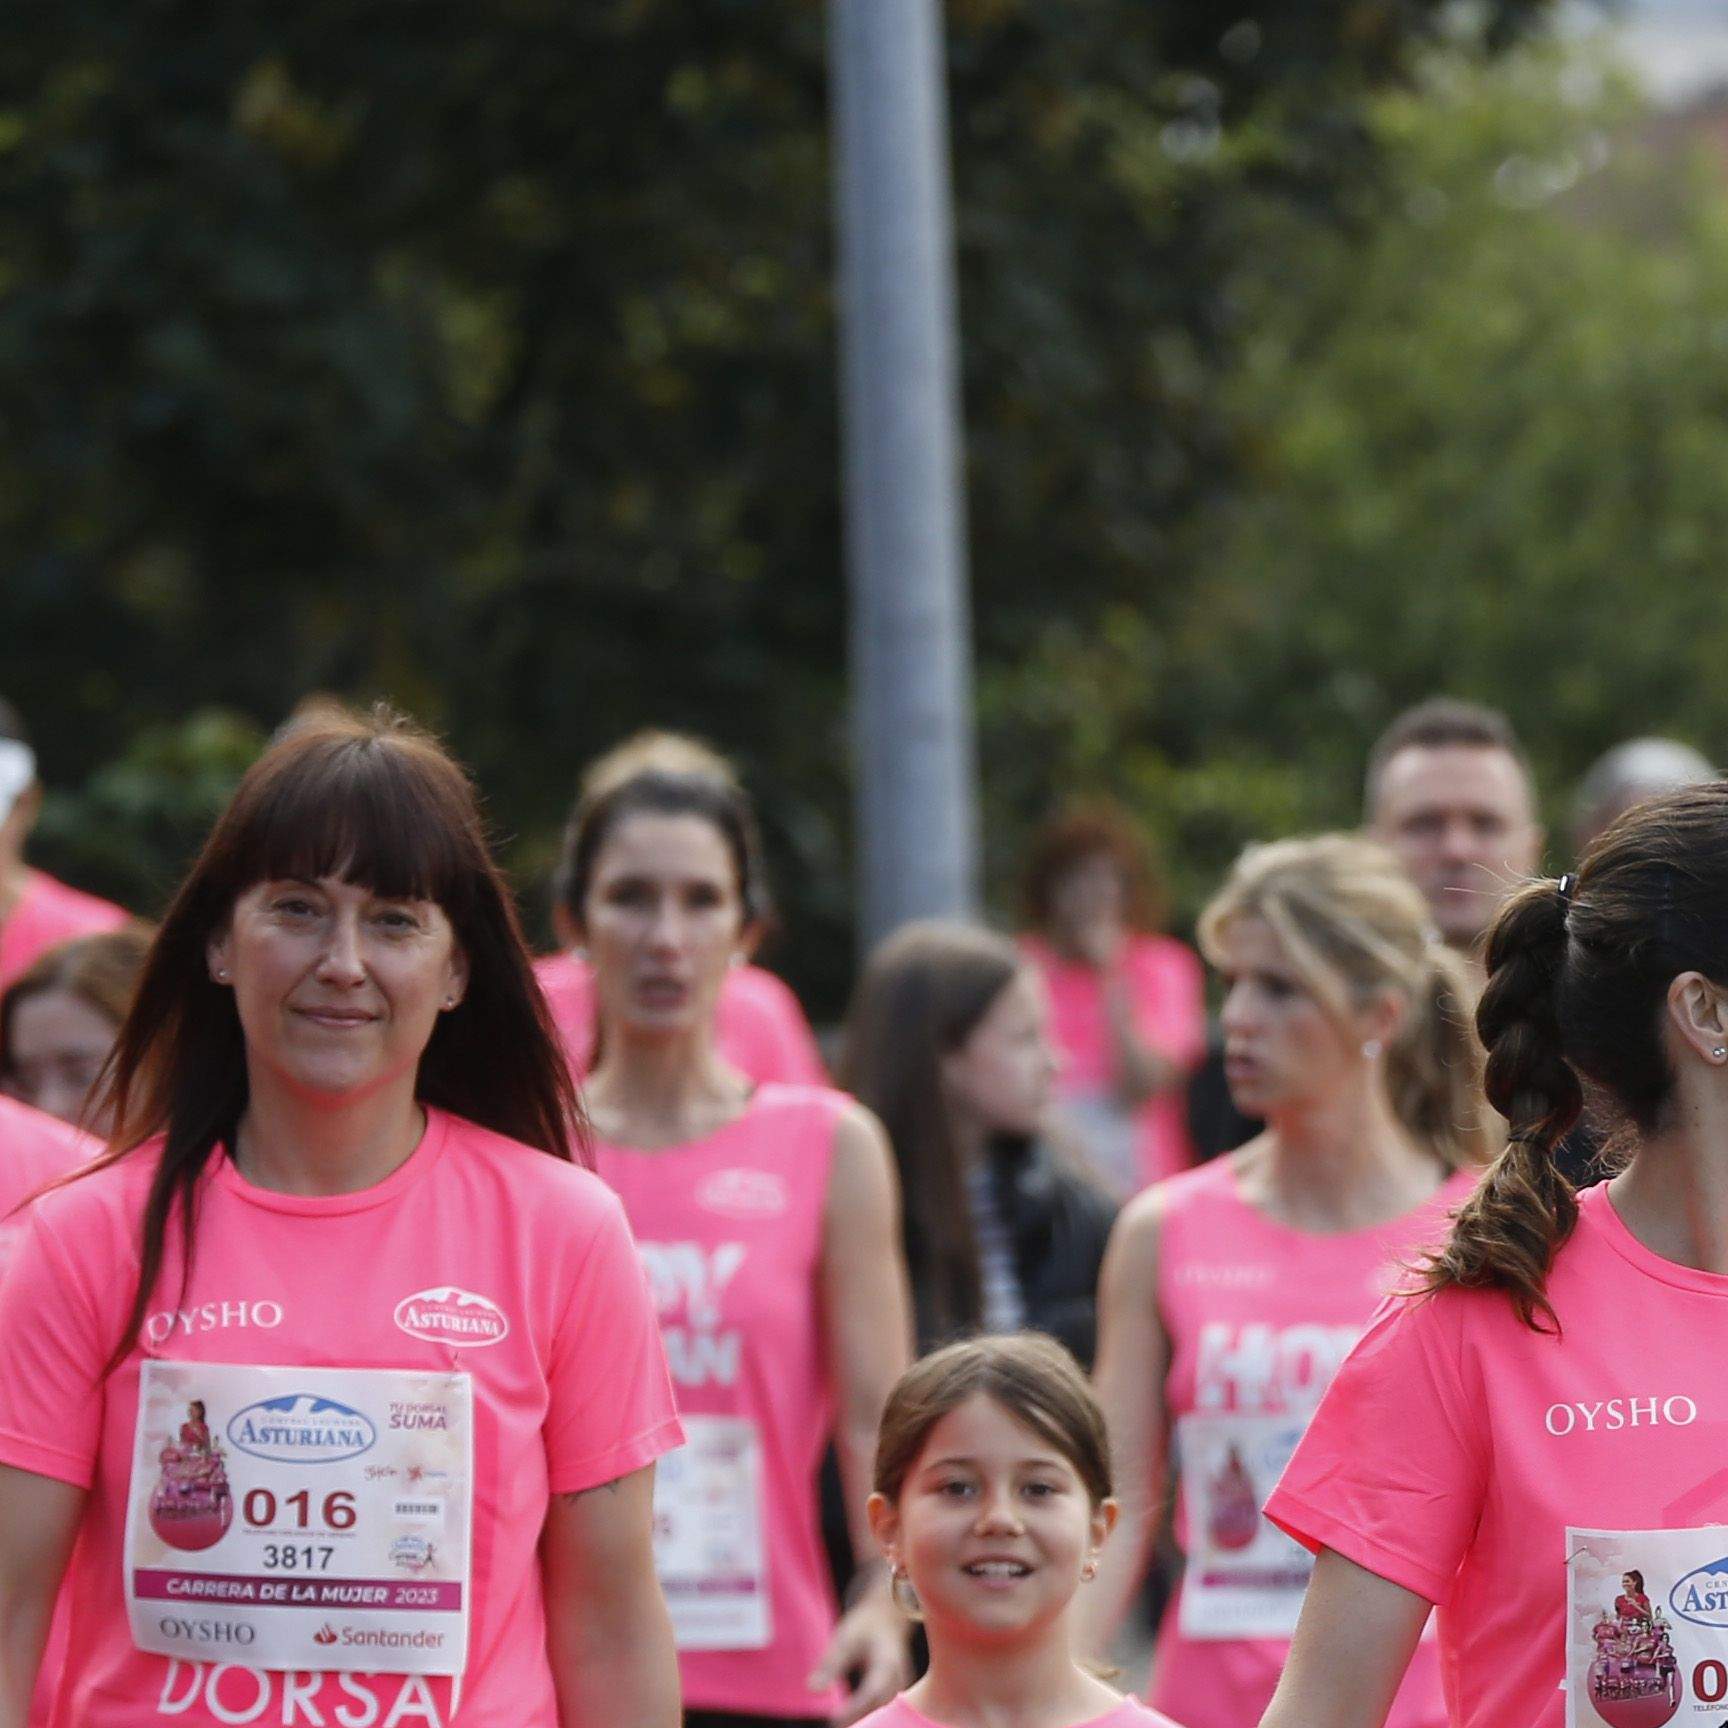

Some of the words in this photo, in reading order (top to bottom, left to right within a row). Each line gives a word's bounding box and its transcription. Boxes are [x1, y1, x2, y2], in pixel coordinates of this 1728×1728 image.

[147, 1299, 283, 1342] OYSHO
[404, 1306, 498, 1338] ASTURIANA
[388, 1414, 447, 1430] SUMA
[1545, 1395, 1697, 1436] OYSHO
[239, 1417, 366, 1447] ASTURIANA
[243, 1488, 357, 1530] 016
[262, 1545, 335, 1571] 3817
[165, 1577, 253, 1600] CARRERA
[258, 1582, 290, 1602] DE
[291, 1583, 317, 1602] LA
[320, 1584, 389, 1605] MUJER
[394, 1586, 440, 1605] 2023
[158, 1617, 256, 1646] OYSHO
[341, 1625, 445, 1650] Santander
